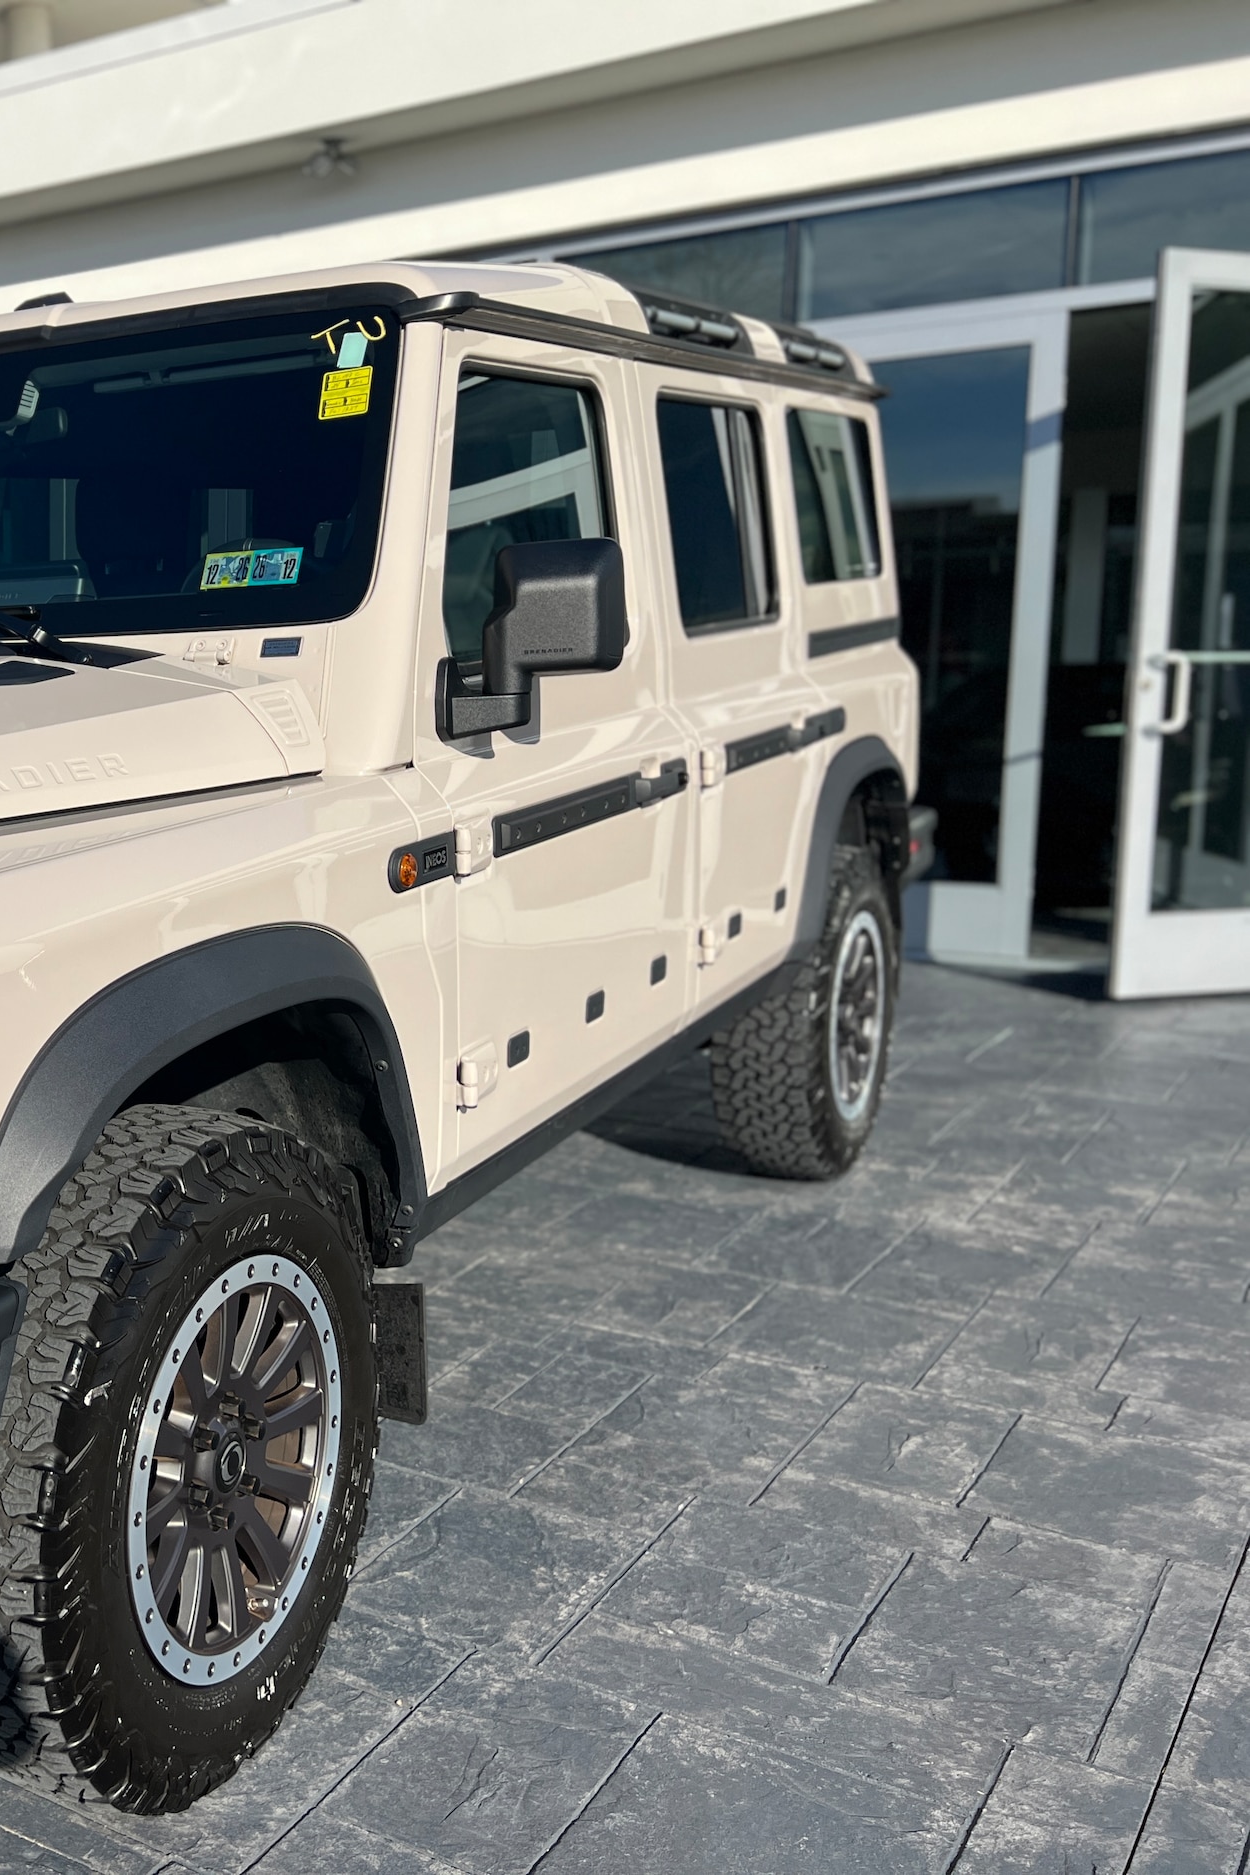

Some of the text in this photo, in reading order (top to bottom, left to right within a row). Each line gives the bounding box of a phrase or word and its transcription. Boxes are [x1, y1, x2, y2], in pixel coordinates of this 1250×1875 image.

[311, 315, 387, 355] T U
[206, 556, 251, 585] 12 26
[282, 558, 297, 580] 12
[425, 850, 447, 870] INEOS
